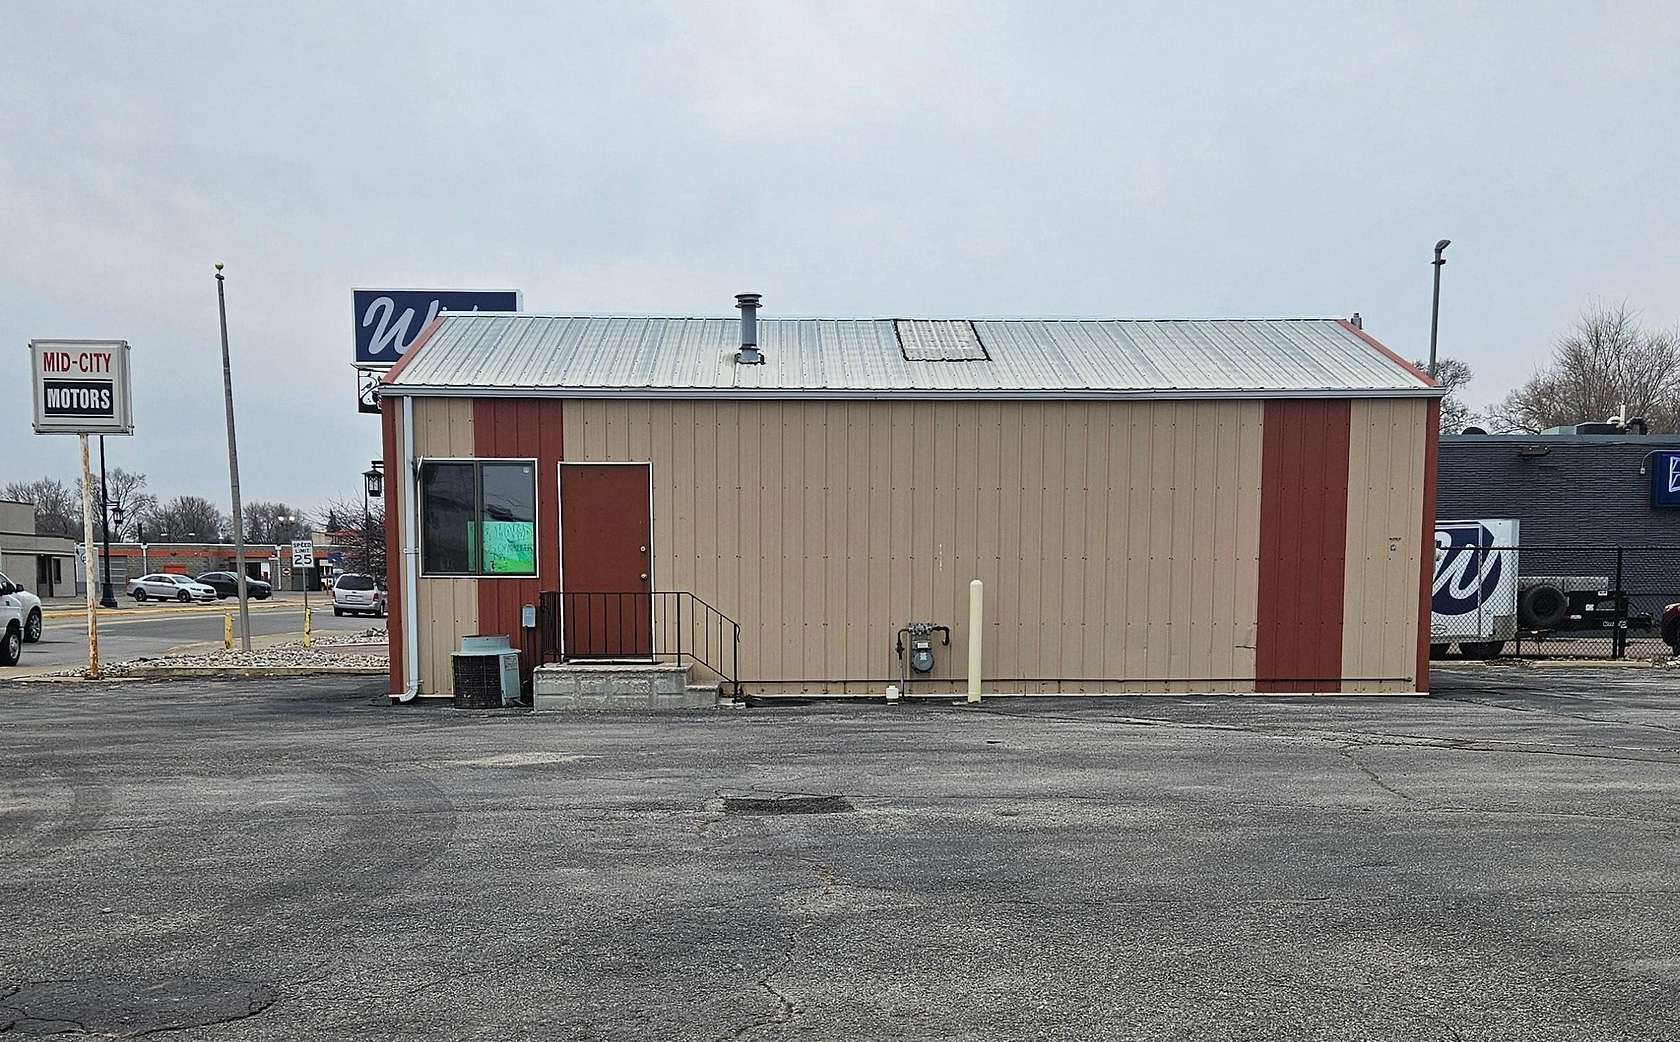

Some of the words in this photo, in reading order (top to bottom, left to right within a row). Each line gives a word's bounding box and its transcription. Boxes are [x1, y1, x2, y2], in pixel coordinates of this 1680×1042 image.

[43, 352, 111, 373] MID-CITY
[47, 388, 110, 409] MOTORS
[294, 554, 312, 565] 25
